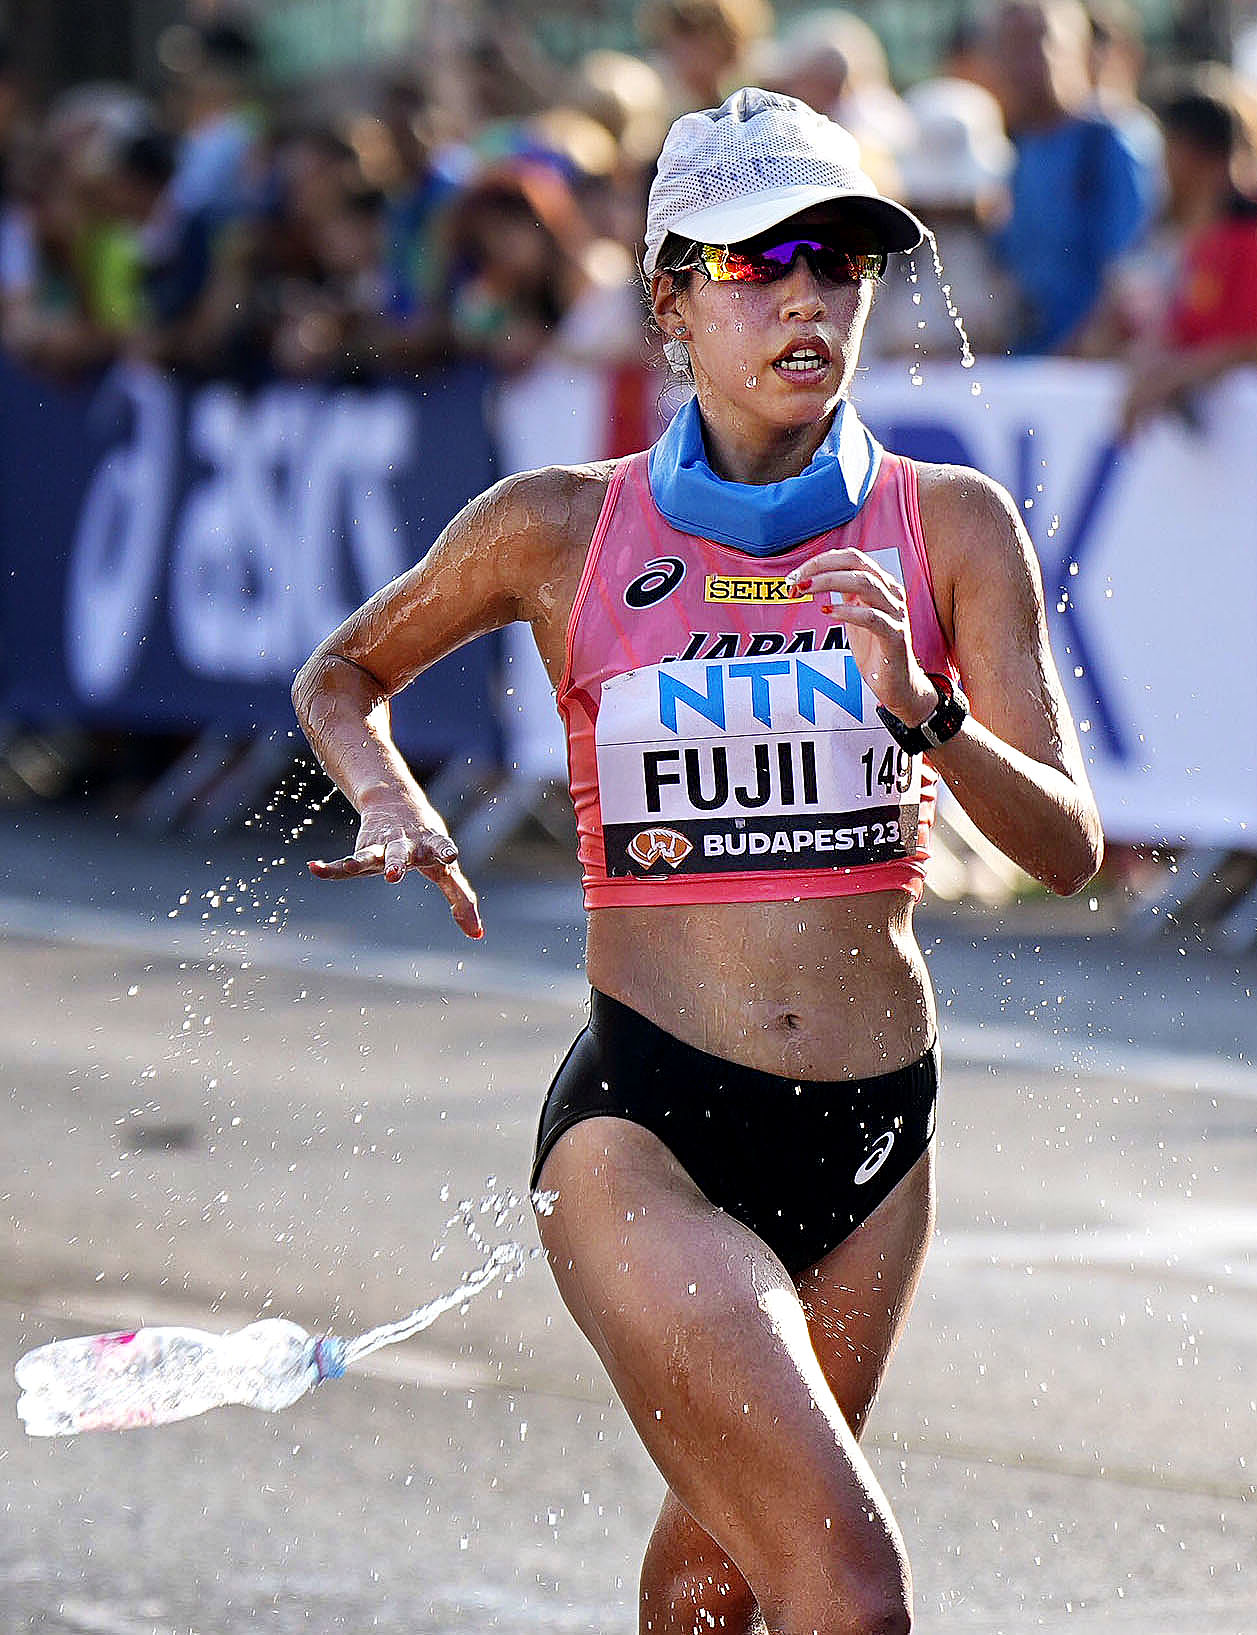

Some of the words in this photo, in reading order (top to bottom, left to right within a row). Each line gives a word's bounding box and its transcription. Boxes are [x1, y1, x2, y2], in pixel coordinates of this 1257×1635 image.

[709, 580, 805, 600] SEIK
[658, 656, 864, 735] NTN
[642, 741, 819, 813] FUJII
[861, 746, 913, 797] 149
[703, 827, 867, 857] BUDAPEST
